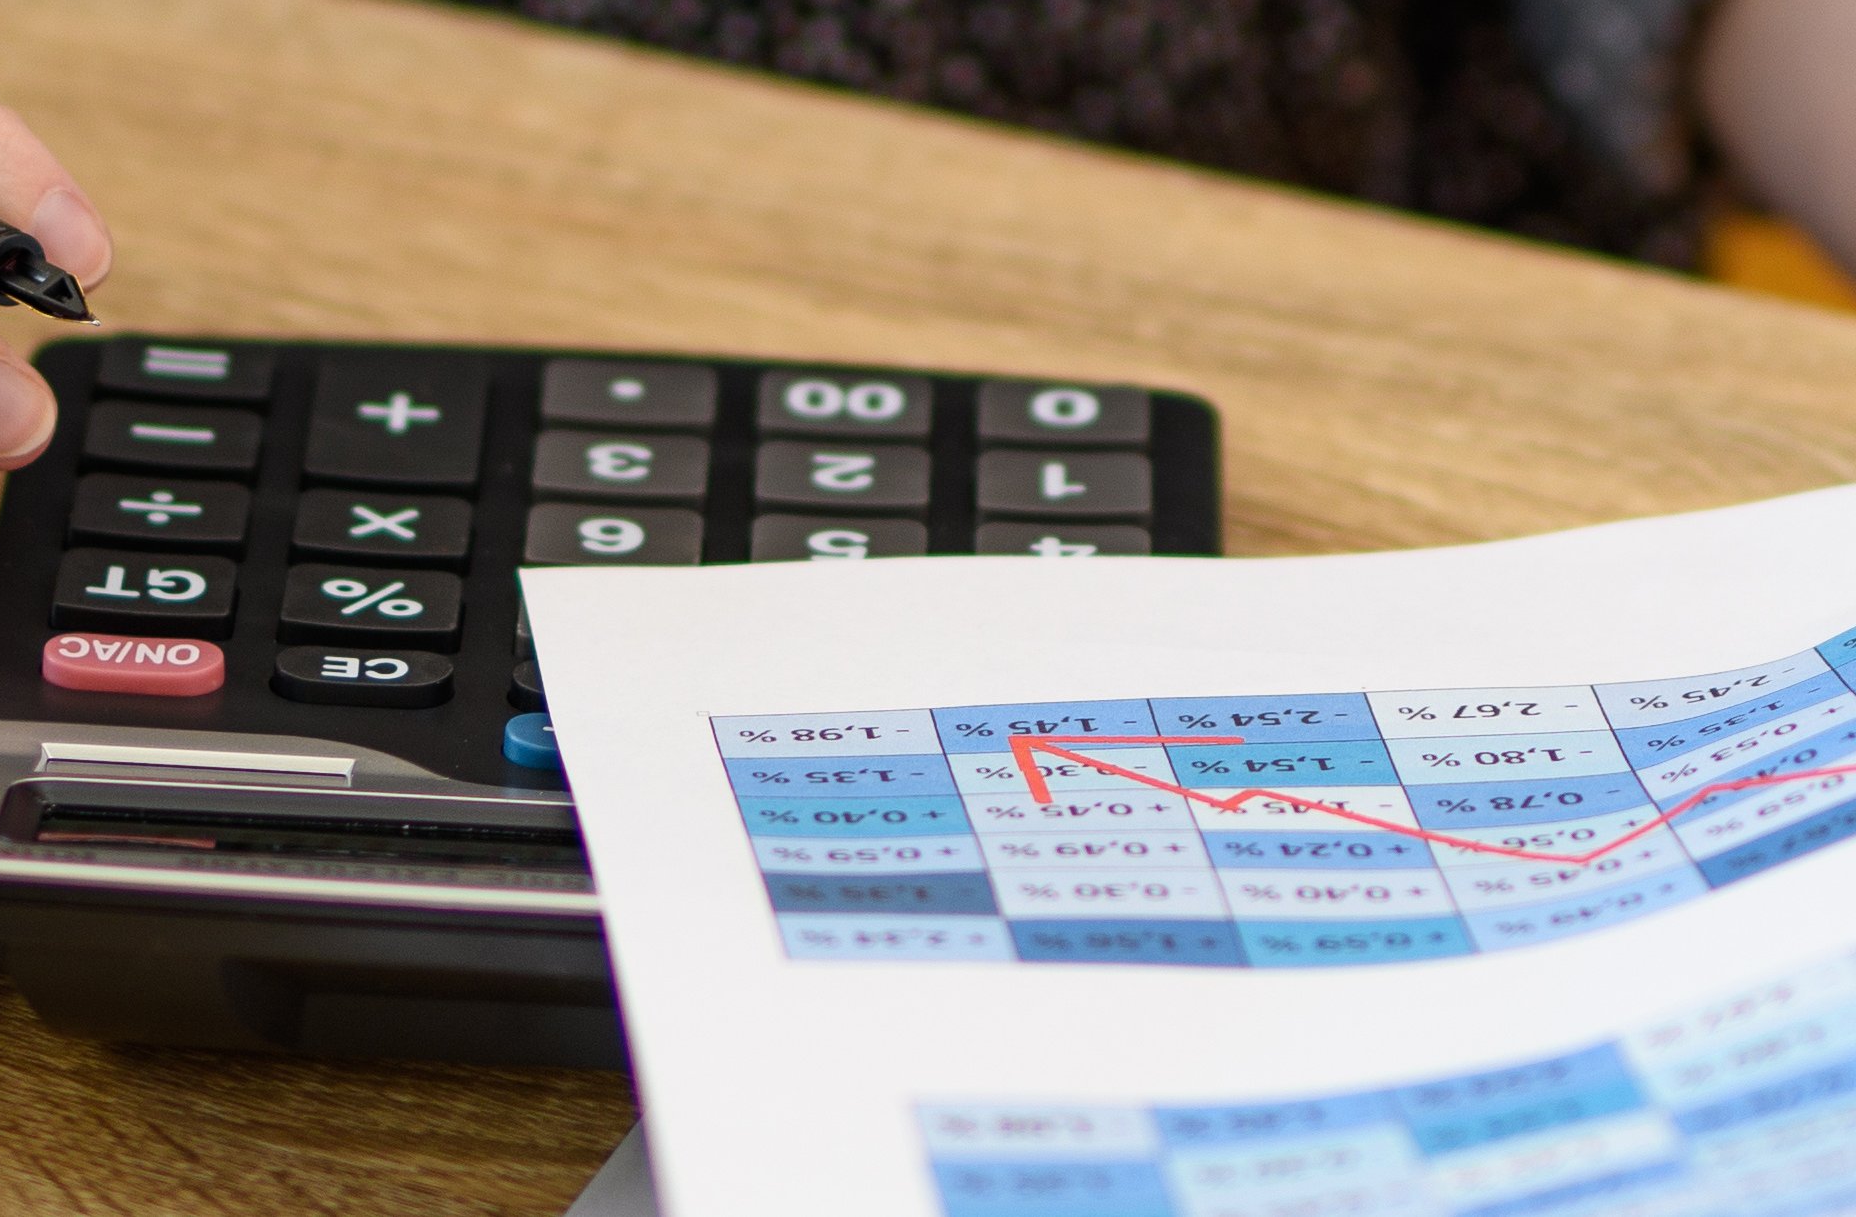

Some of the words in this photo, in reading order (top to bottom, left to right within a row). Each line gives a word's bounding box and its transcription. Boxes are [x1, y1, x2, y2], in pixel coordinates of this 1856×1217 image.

[783, 379, 906, 418] 00
[1029, 388, 1100, 426] 0
[586, 442, 652, 480] 3
[811, 453, 875, 490] 2
[1041, 461, 1088, 500] 1
[576, 517, 645, 555] 6
[807, 530, 870, 561] 5
[85, 564, 207, 602] GT
[321, 578, 424, 617] %
[56, 634, 201, 666] ON/AC
[319, 654, 410, 681] CE
[1681, 673, 1771, 704] 2,45
[1450, 699, 1541, 719] 2,67
[1629, 694, 1668, 711] %
[1177, 713, 1217, 728] %
[1229, 708, 1322, 726] 2,54
[1397, 705, 1436, 720] %
[1697, 700, 1784, 735] 1,35
[790, 724, 882, 742] 1,98
[955, 722, 994, 737] %
[1007, 715, 1099, 735] 1,45
[738, 729, 777, 743] %
[1647, 734, 1685, 752] %
[1710, 723, 1797, 762] 0,53
[1241, 755, 1335, 772] 1,54
[1420, 751, 1461, 768] %
[1473, 746, 1565, 766] 1,80
[804, 767, 894, 783] 1,35
[975, 765, 1014, 780] %
[1190, 759, 1230, 774] %
[1660, 763, 1697, 784] %
[751, 770, 790, 784] %
[1039, 801, 1134, 818] 0,45
[1436, 797, 1476, 814] %
[1488, 790, 1583, 811] 0,78
[758, 809, 799, 824] %
[813, 808, 908, 824] 0,40
[985, 805, 1026, 820] %
[1500, 827, 1595, 850] 0,56
[770, 846, 812, 862] %
[826, 846, 922, 862] 0,59
[998, 842, 1041, 857] %
[1054, 840, 1149, 857] 0,49
[1224, 841, 1265, 858] %
[1279, 840, 1373, 859] 0,24
[1527, 857, 1622, 887] 045
[1072, 881, 1170, 900] 0,30
[1240, 884, 1282, 901] %
[1295, 883, 1390, 903] 0,40
